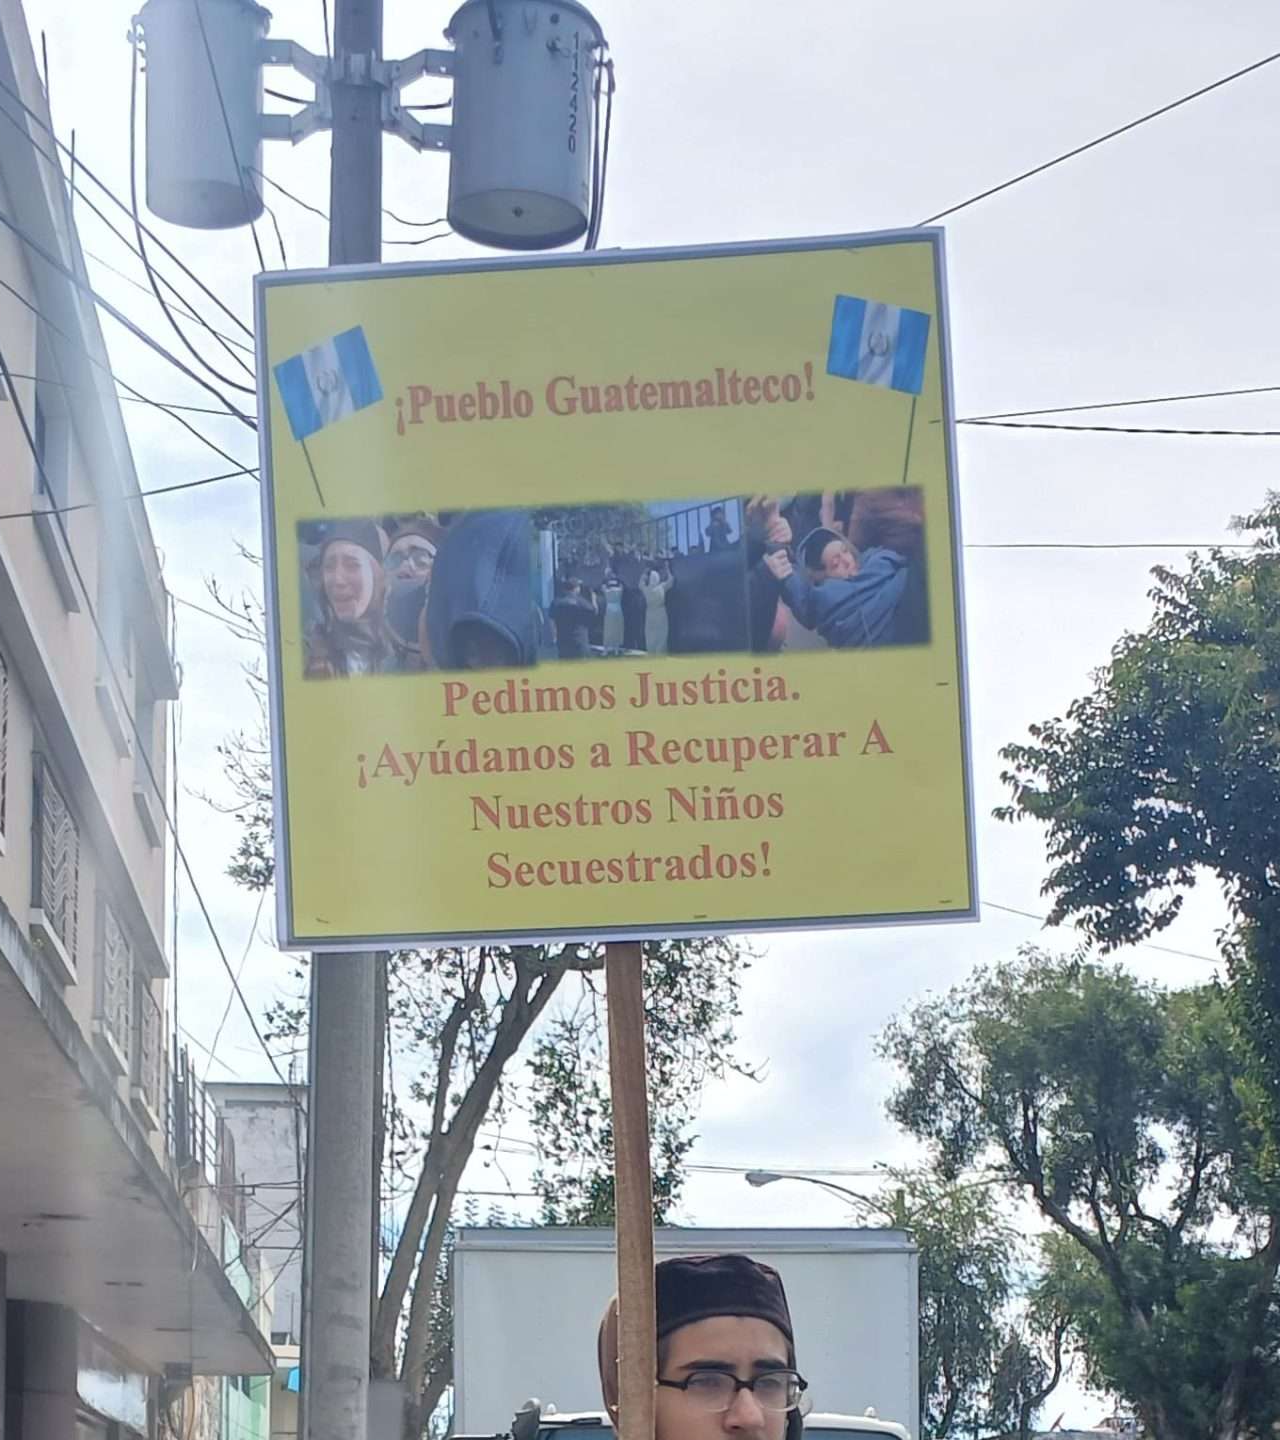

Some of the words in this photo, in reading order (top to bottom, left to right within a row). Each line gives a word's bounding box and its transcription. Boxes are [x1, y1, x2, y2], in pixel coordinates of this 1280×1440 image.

[393, 380, 533, 436] ¡Pueblo
[545, 361, 815, 417] Guatemalteco!
[442, 678, 616, 718] Pedimos
[629, 667, 801, 708] Justicia.
[356, 737, 575, 789] ¡Ayúdanos
[590, 742, 612, 769] a
[625, 724, 847, 773] Recuperar
[859, 720, 894, 755] A
[470, 793, 653, 831] Nuestros
[666, 786, 785, 826] Niños
[486, 842, 772, 889] Secuestrados!
